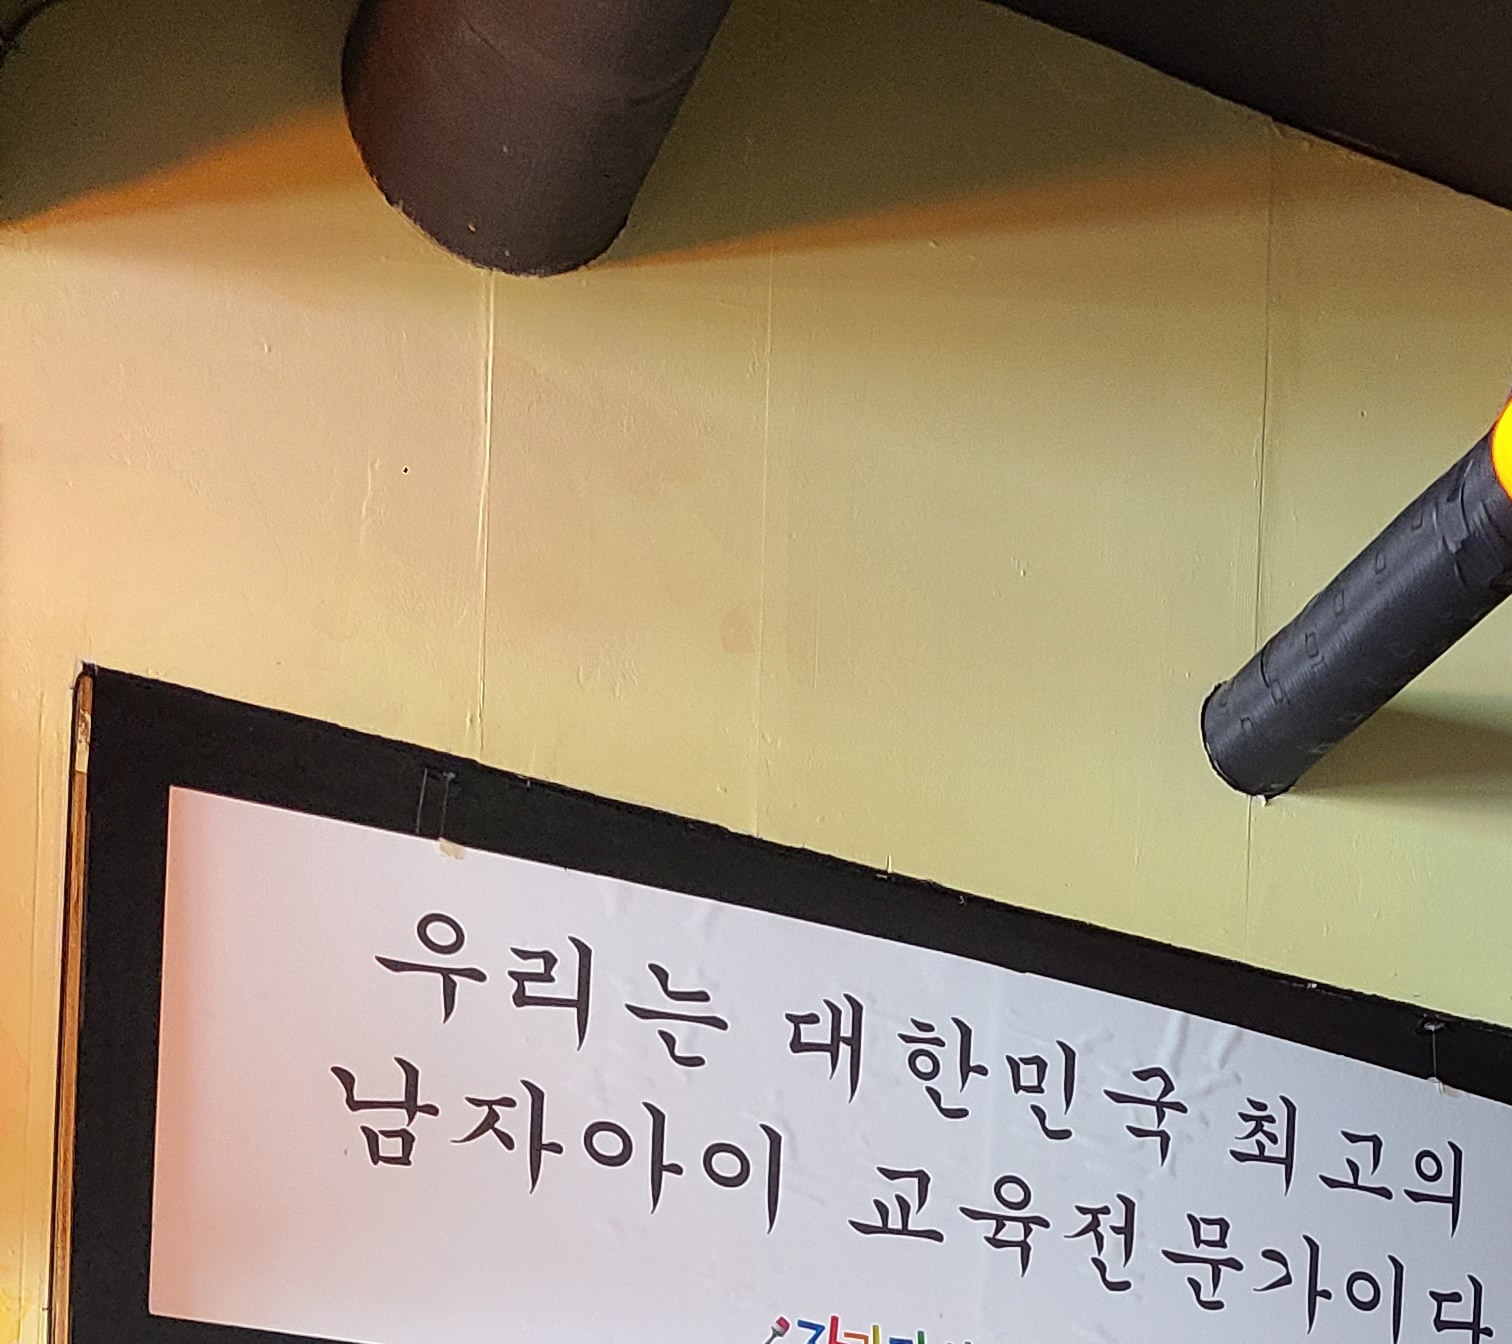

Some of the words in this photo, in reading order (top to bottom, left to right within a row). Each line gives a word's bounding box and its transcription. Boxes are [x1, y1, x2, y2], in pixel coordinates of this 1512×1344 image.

[331, 1059, 785, 1232] 남자아이
[375, 910, 730, 1066] 우리는
[785, 996, 1190, 1166] 대한민국
[1229, 1094, 1466, 1237] 최고의
